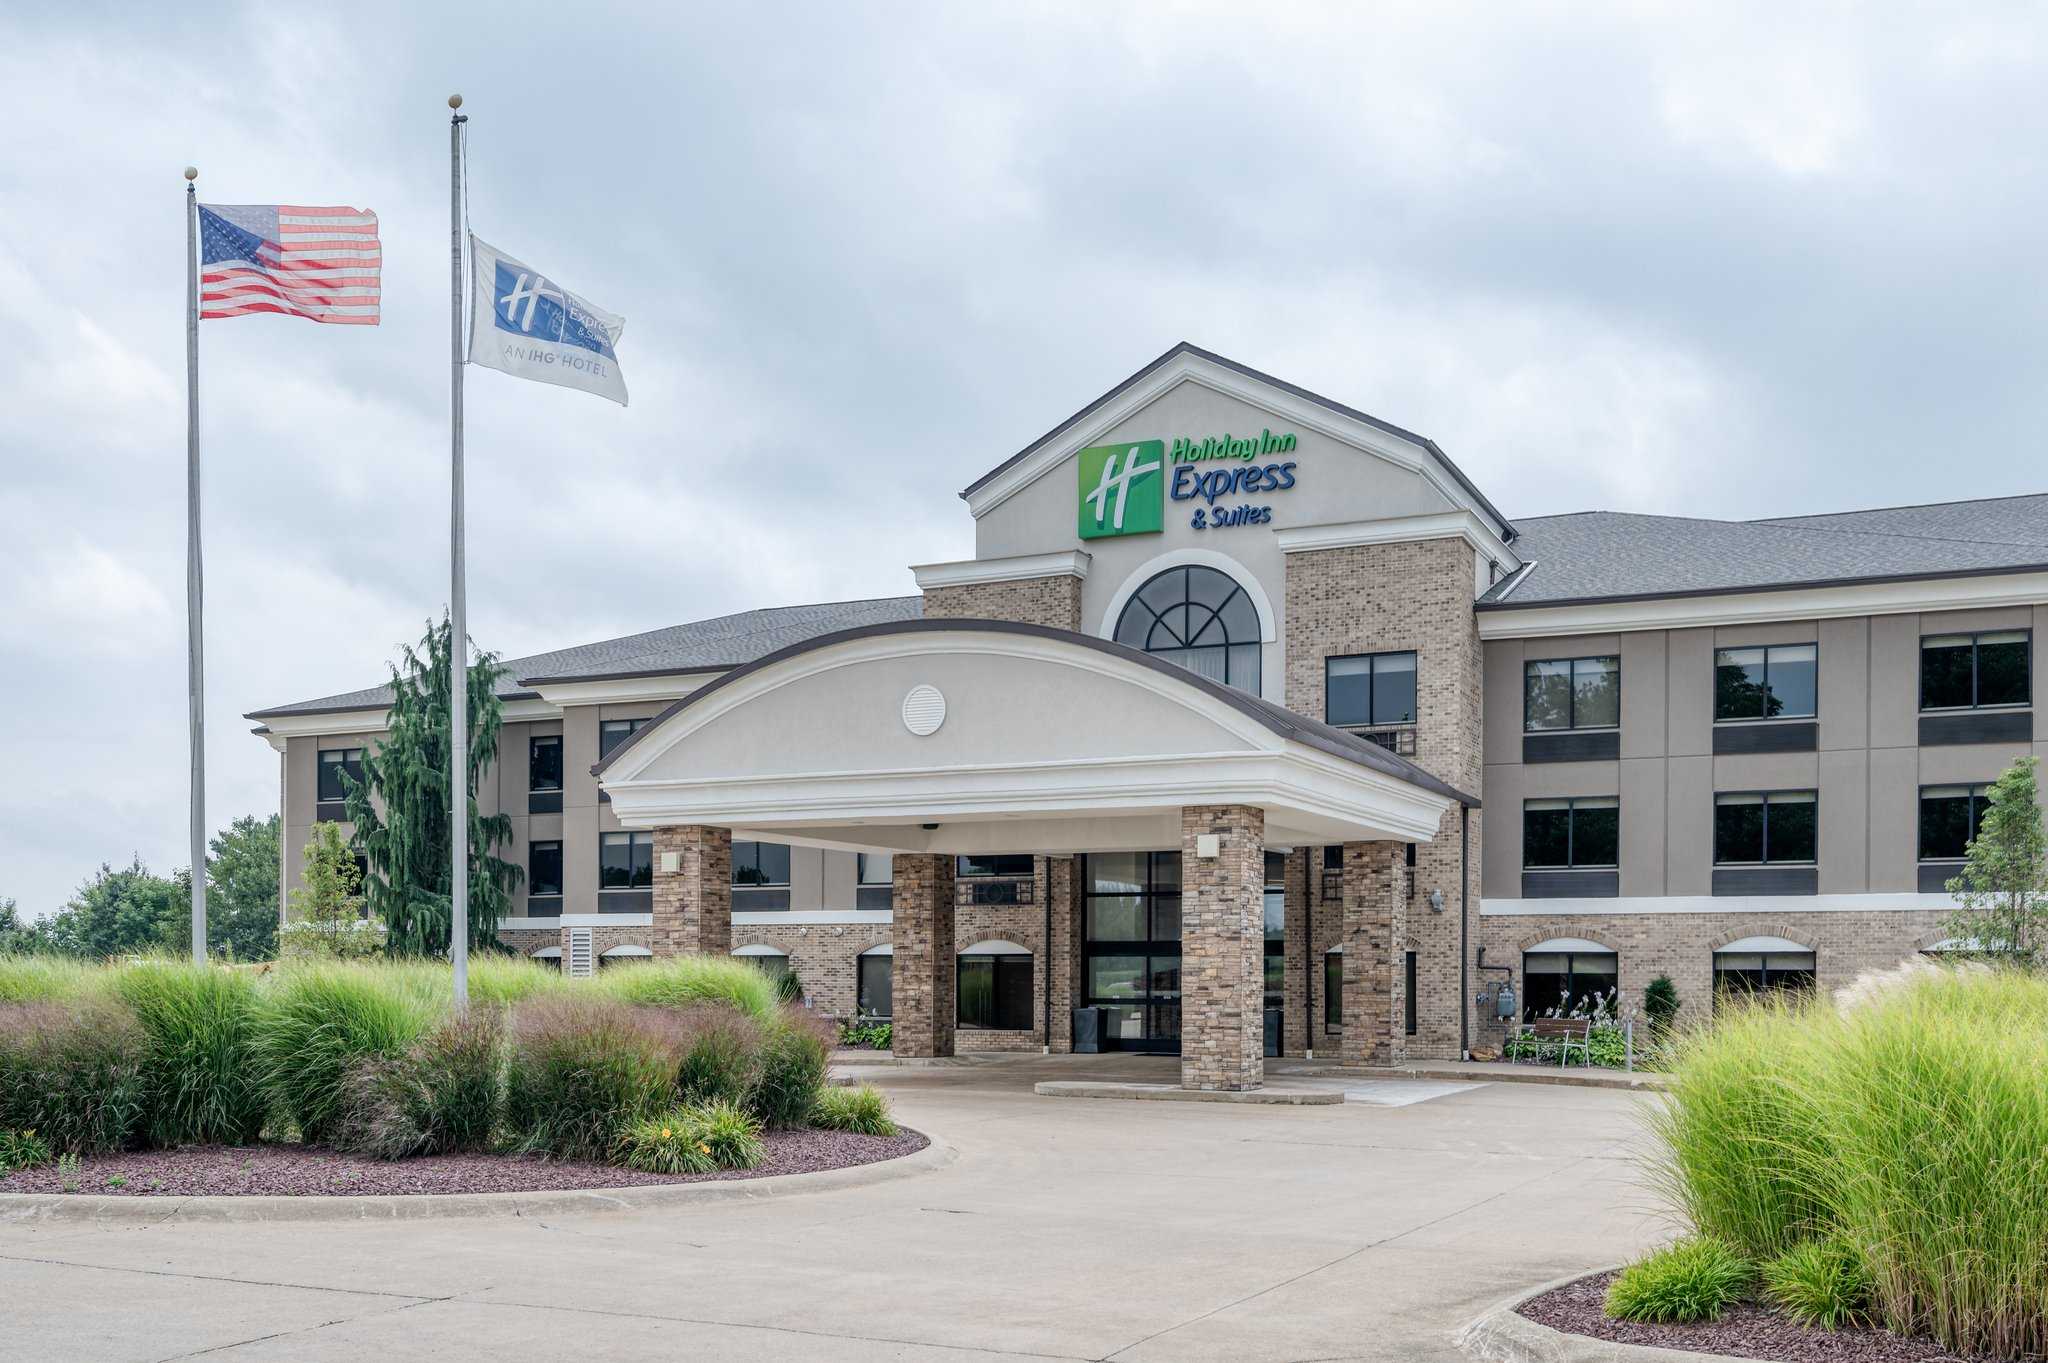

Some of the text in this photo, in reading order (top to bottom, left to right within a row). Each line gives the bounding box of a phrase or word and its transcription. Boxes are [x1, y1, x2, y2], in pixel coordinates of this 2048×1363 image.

[505, 345, 526, 361] AN
[562, 355, 608, 378] HOTEL
[1169, 428, 1297, 464] Holiday Inn
[1170, 462, 1297, 505] Express
[1190, 504, 1272, 529] & Suites
